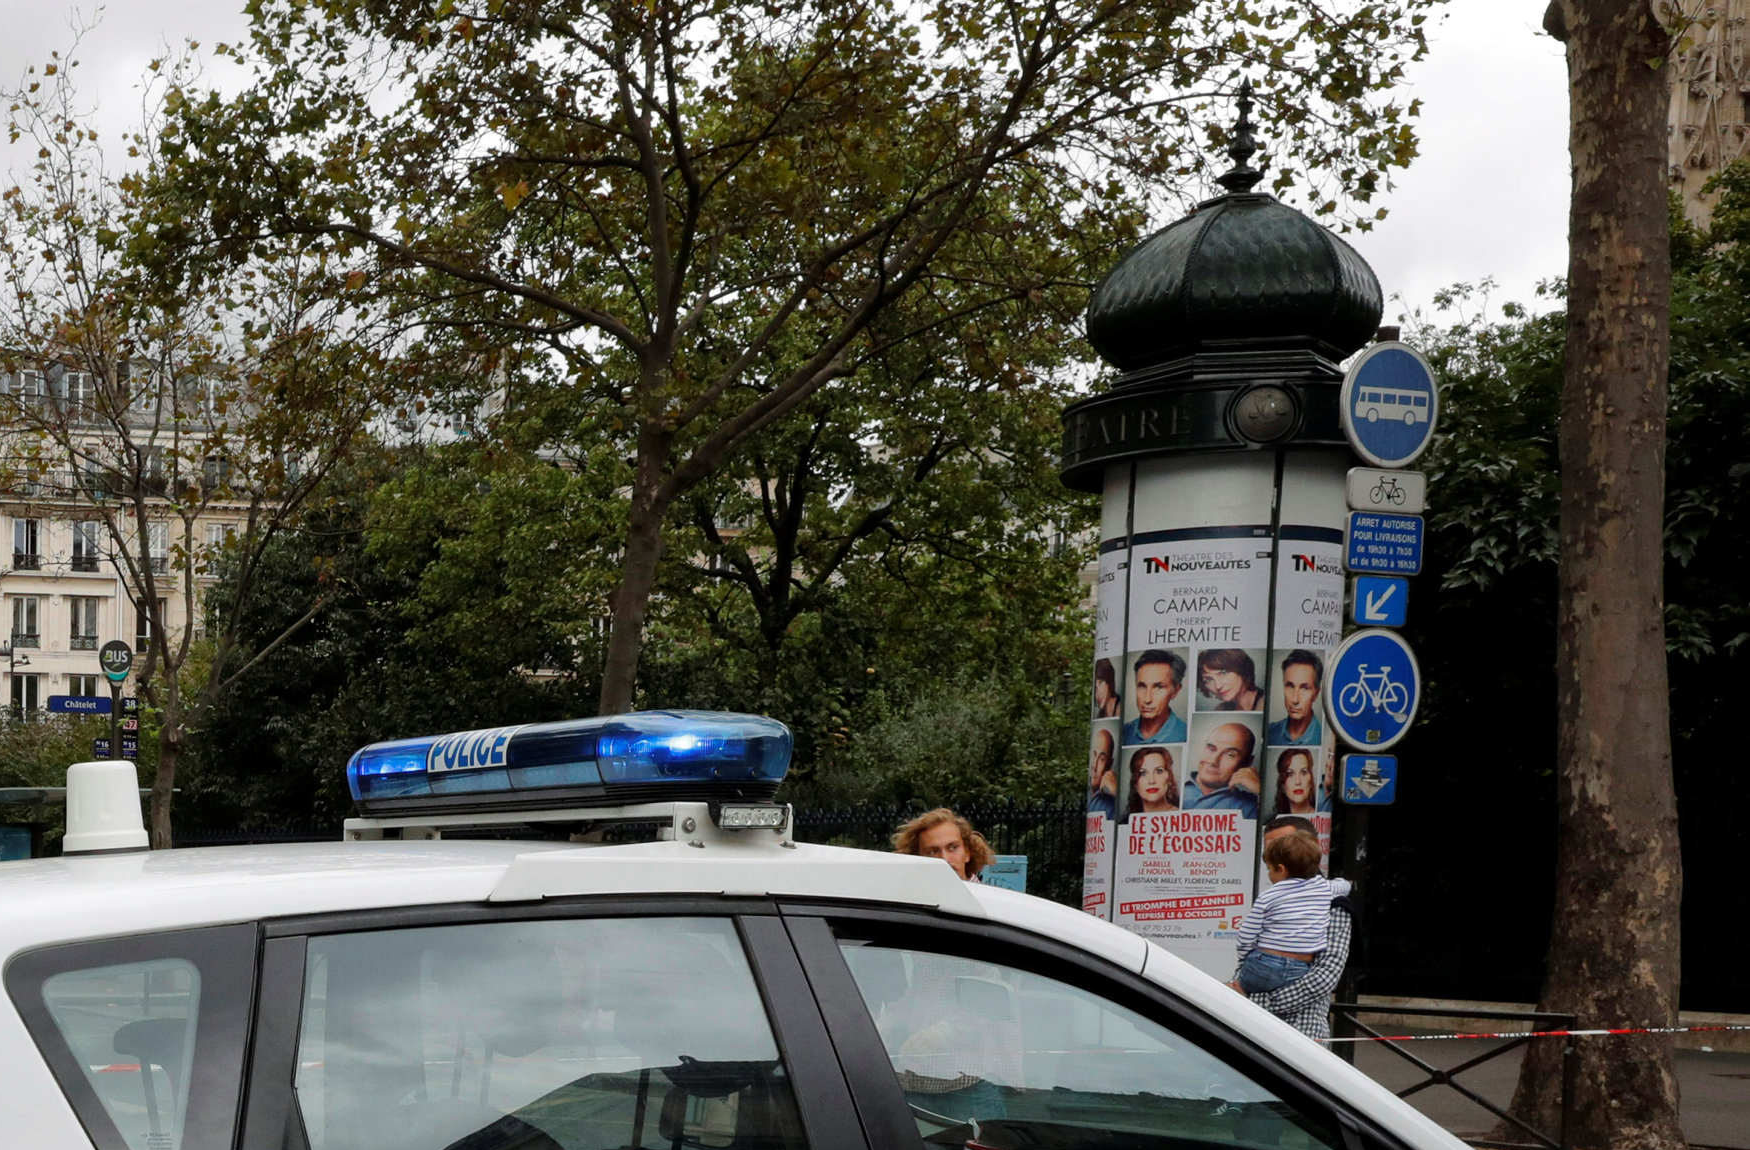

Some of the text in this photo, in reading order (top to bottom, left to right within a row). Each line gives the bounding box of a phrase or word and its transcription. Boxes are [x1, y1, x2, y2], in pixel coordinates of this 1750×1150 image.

[1356, 517, 1416, 530] ARRET AUTORISE
[1353, 531, 1417, 544] POUR LIVRAISONS
[1356, 544, 1365, 553] de
[1215, 551, 1234, 560] DES
[1143, 556, 1169, 574] TN
[1172, 586, 1218, 596] BERNARD
[1153, 596, 1238, 614] CAMPAN
[1176, 617, 1212, 626] THIERRY
[1148, 626, 1241, 645] LHERMITTE
[105, 650, 128, 662] BUS
[64, 700, 97, 709] Châtelet
[124, 700, 136, 710] 38
[124, 720, 136, 729] 47
[430, 729, 516, 771] POLICE
[1132, 812, 1238, 834] LE SYNDROME
[1129, 835, 1146, 855] DE
[1142, 860, 1172, 868] ISABELLE
[1183, 861, 1227, 869] JEAN-LOUIS
[1146, 868, 1175, 876] NOUVEL
[1184, 877, 1220, 885] FLORENCE
[1122, 904, 1130, 913] LE
[1132, 901, 1178, 912] TRIOMPHE
[1179, 899, 1192, 908] DE
[1136, 911, 1165, 920] REPRISE
[1166, 911, 1175, 919] LE
[1184, 909, 1223, 918] OCTOBRE
